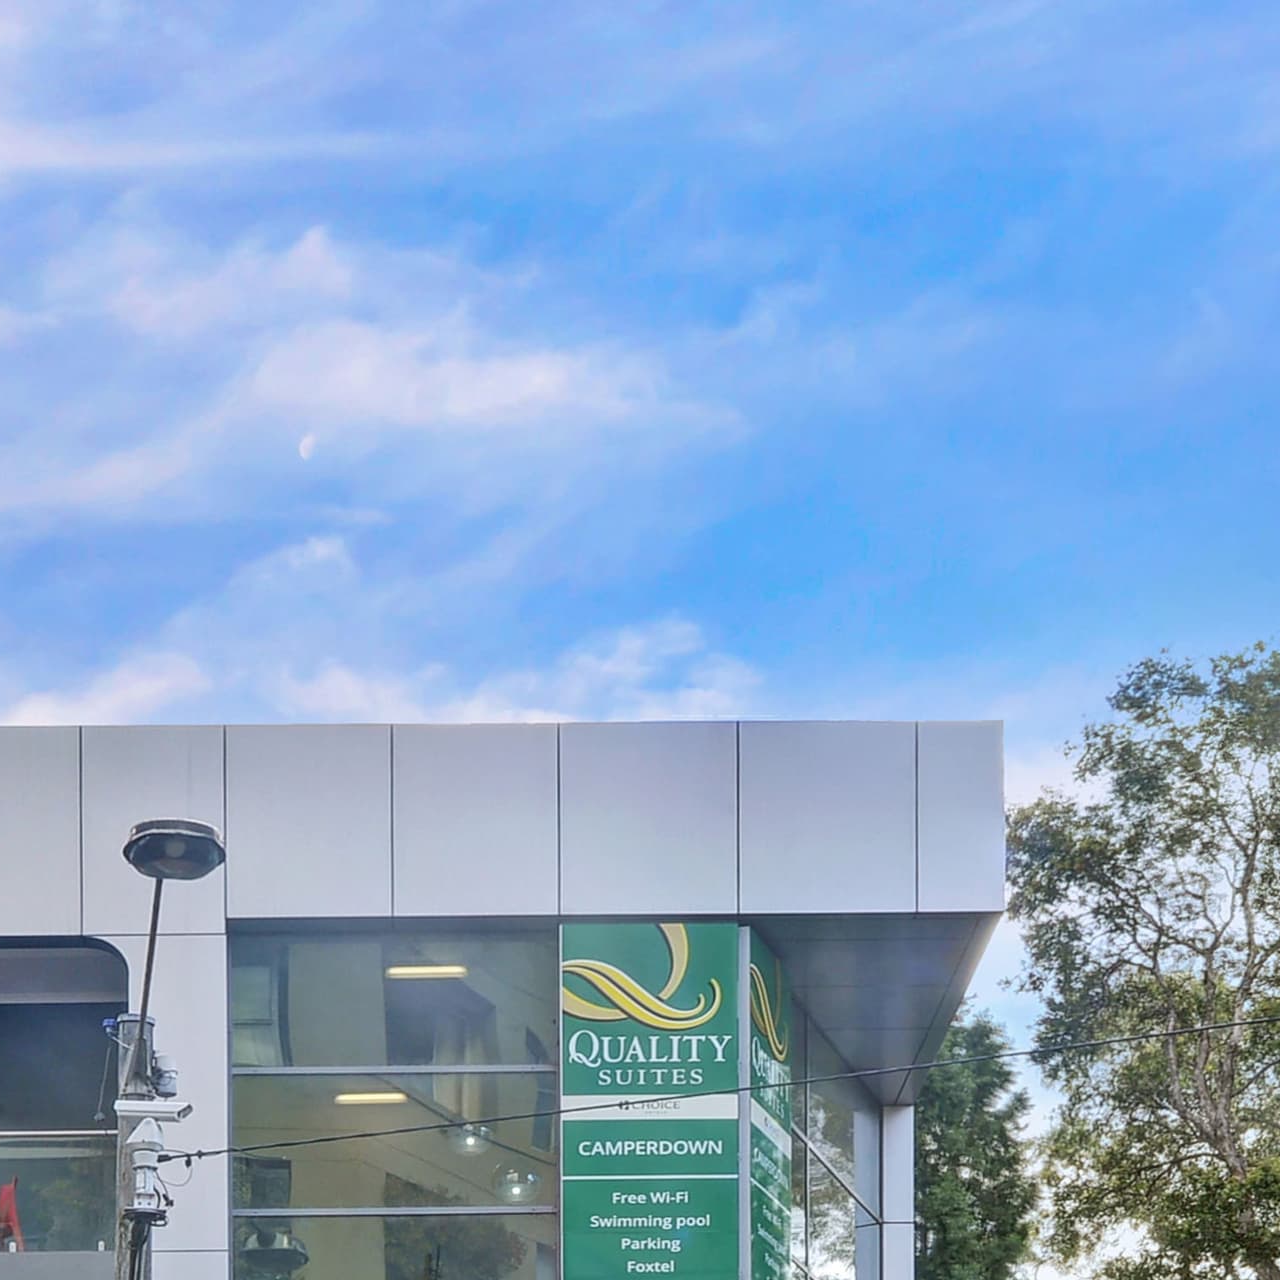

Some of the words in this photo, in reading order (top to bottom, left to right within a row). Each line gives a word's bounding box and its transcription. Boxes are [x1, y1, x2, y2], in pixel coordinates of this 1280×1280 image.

[568, 1029, 733, 1067] QUALITY
[598, 1069, 703, 1085] SUITES
[631, 1100, 680, 1110] CHOICE
[578, 1140, 723, 1156] CAMPERDOWN
[612, 1192, 646, 1204] Free
[650, 1191, 689, 1204] Wi-Fi
[590, 1215, 672, 1230] Swimming
[676, 1214, 711, 1230] pool
[621, 1237, 681, 1252] Parking
[627, 1260, 675, 1273] Foxtel
